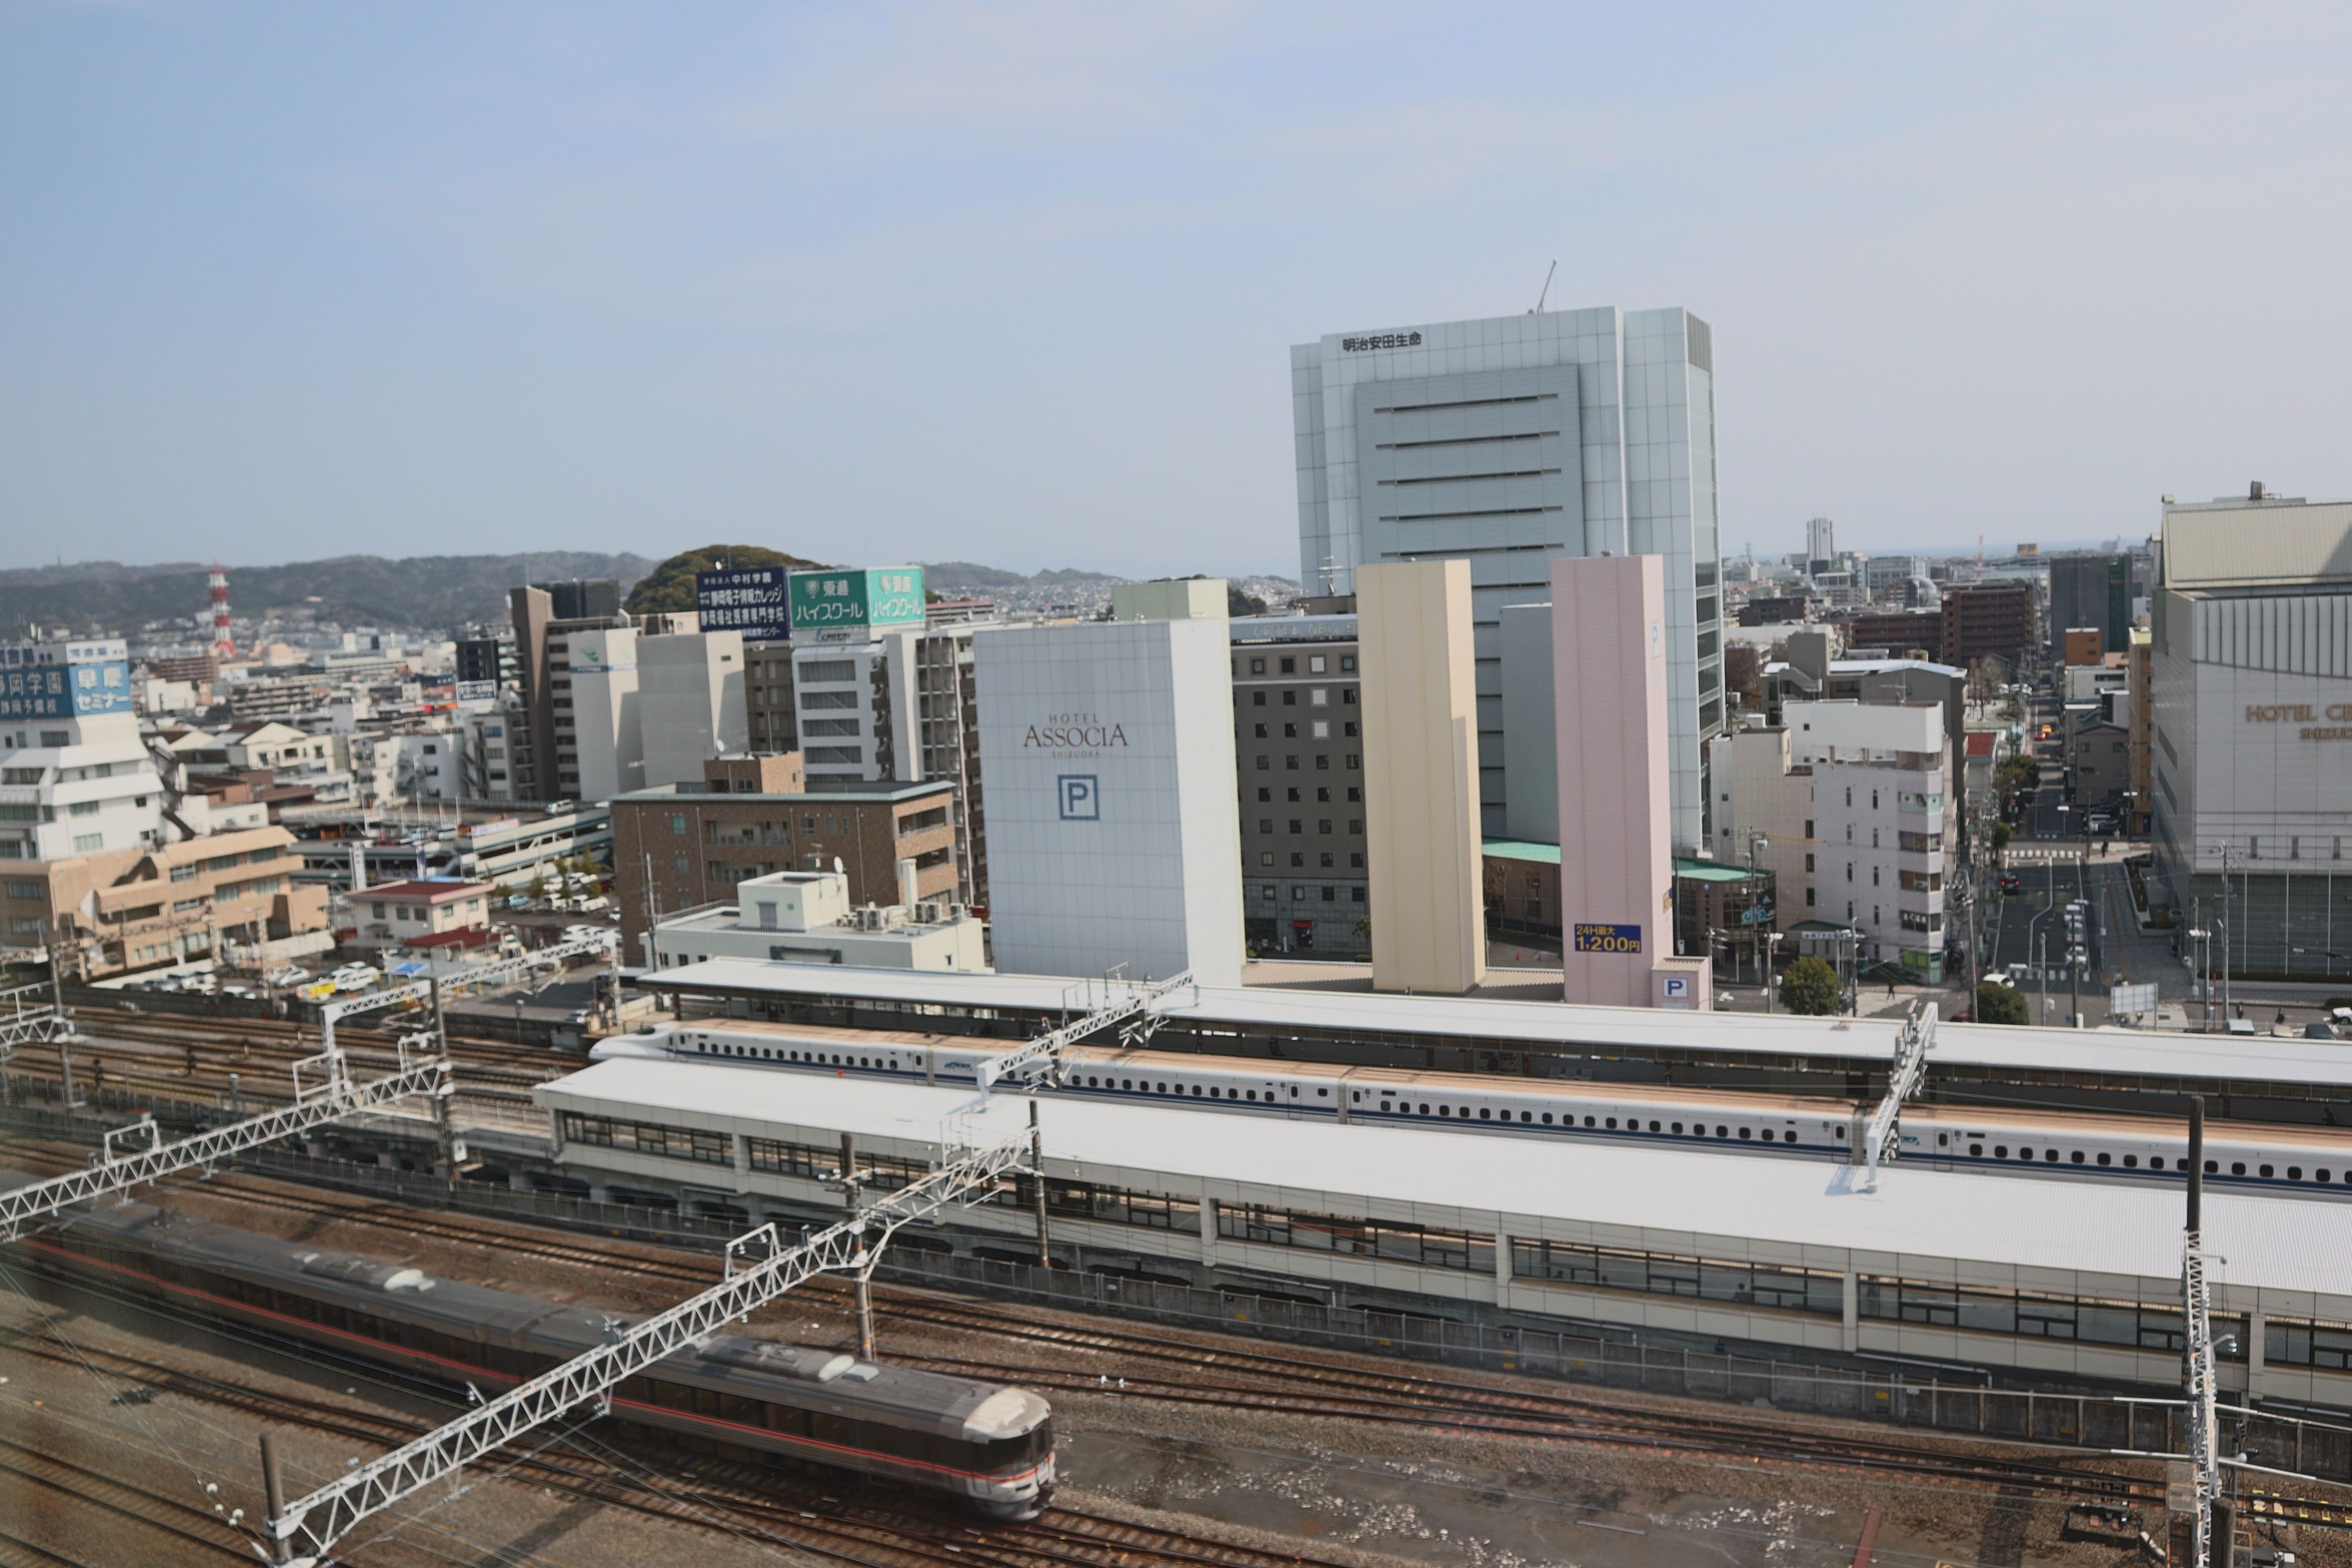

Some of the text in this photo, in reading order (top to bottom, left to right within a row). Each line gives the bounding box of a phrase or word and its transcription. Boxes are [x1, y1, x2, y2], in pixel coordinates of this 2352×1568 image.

[1343, 331, 1422, 352] 明治安田生命
[823, 580, 849, 597] 東進
[892, 576, 912, 594] 東進
[796, 603, 864, 620] ハイスクール
[873, 598, 922, 618] ハイスクール
[76, 691, 129, 711] セミナー
[1049, 713, 1099, 724] HOTEL
[2246, 704, 2318, 722] HOTEL
[1023, 723, 1129, 747] ASSOCIA
[1068, 782, 1088, 812] P
[1576, 925, 1615, 936] 24H最大
[1577, 937, 1640, 952] 1,200円
[1667, 980, 1683, 995] P
